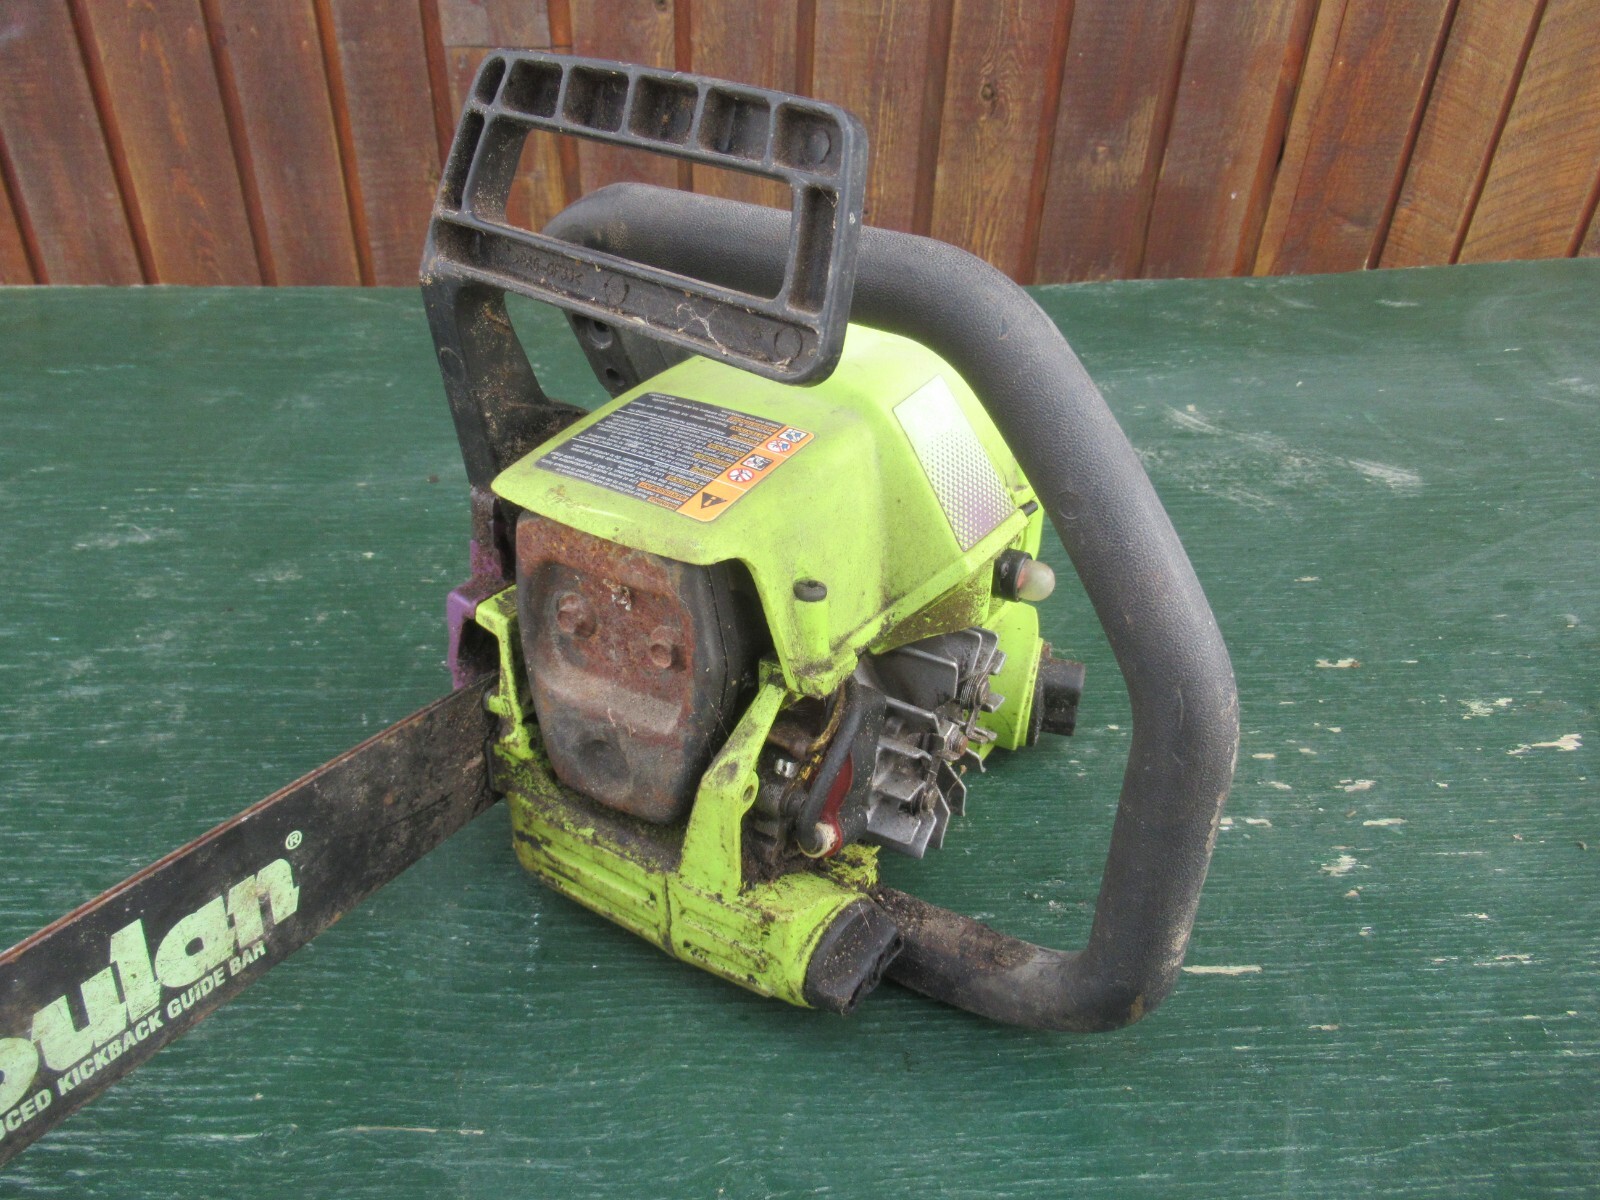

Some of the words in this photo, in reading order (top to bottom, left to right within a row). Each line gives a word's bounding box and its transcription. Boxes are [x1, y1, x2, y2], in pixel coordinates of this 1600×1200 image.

[57, 1009, 164, 1096] KICKBACK
[167, 969, 226, 1019] GUIDE
[230, 940, 267, 977] BAR
